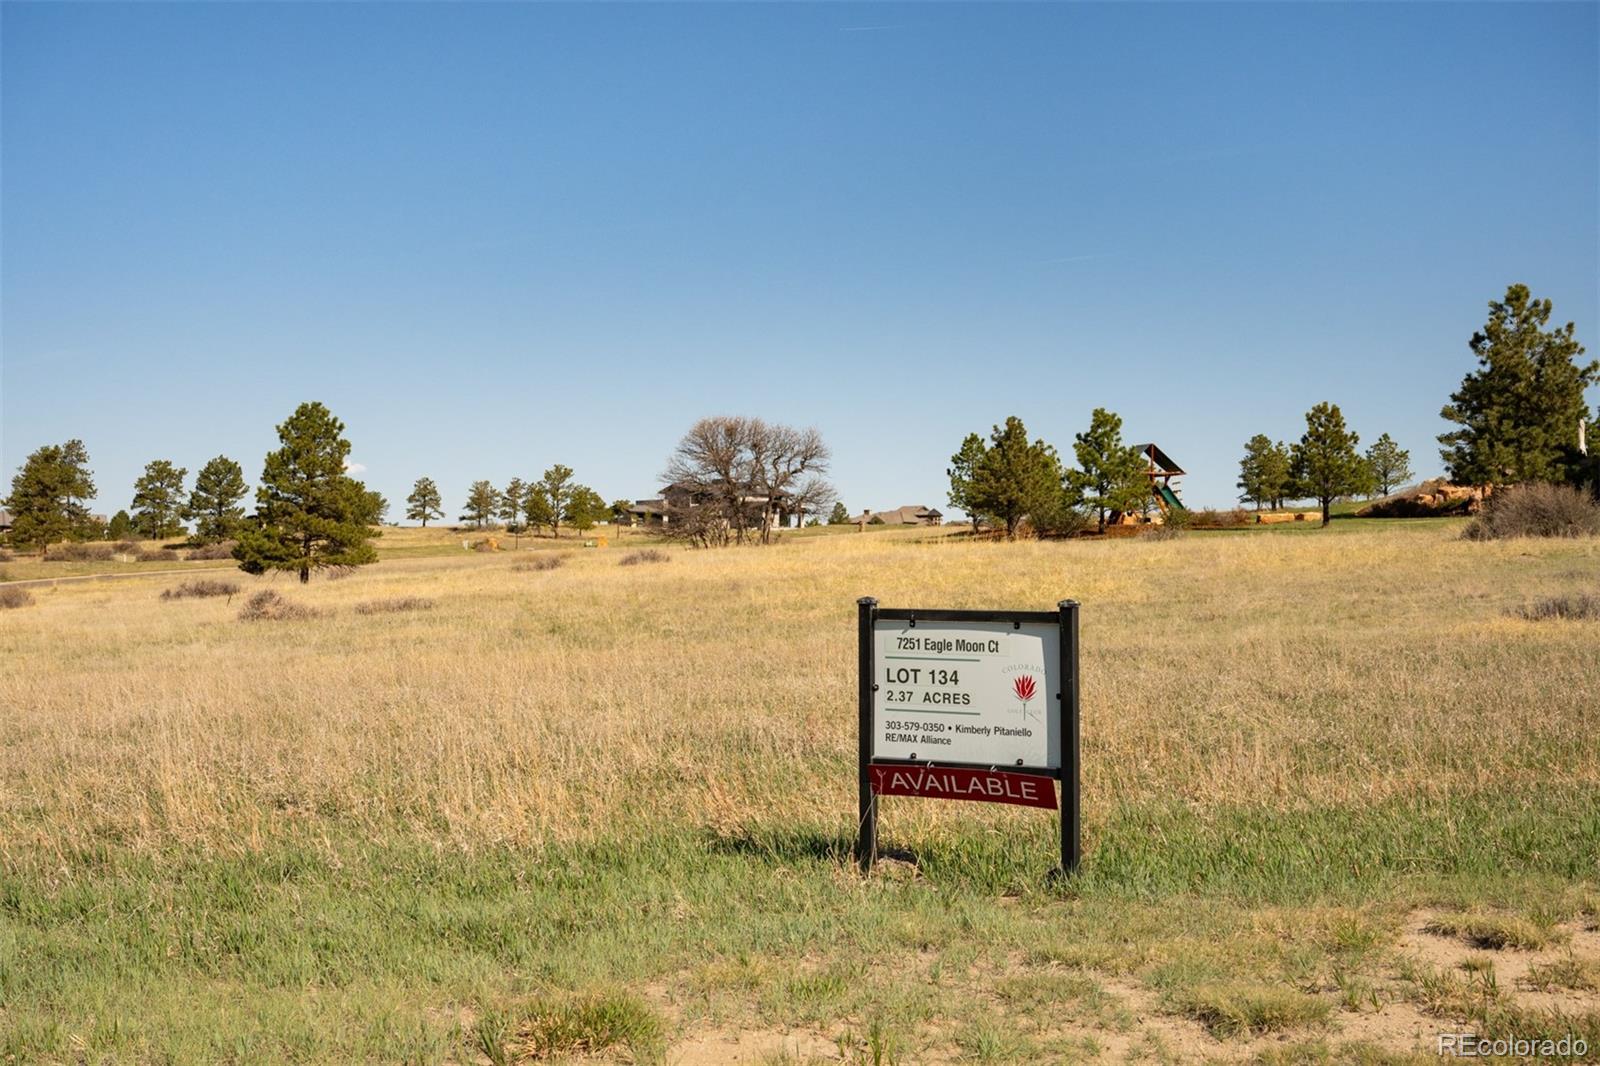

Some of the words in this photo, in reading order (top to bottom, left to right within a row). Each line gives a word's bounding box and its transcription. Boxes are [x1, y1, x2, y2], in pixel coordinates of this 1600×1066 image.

[897, 637, 921, 651] 7251
[924, 639, 953, 654] Eagle
[956, 639, 985, 653] Moon
[988, 640, 999, 653] Ct
[886, 668, 921, 684] LOT
[928, 670, 959, 686] 134
[1001, 663, 1048, 675] COLORADO
[886, 690, 914, 702] 2.37
[923, 692, 971, 705] ACRES
[885, 721, 945, 733] 303-579-0350
[955, 724, 991, 737] Kimberly
[994, 726, 1032, 737] Pitaniello
[885, 733, 918, 743] RE/MAX
[920, 734, 952, 745] Alliance
[891, 772, 1039, 800] AVAILABLE
